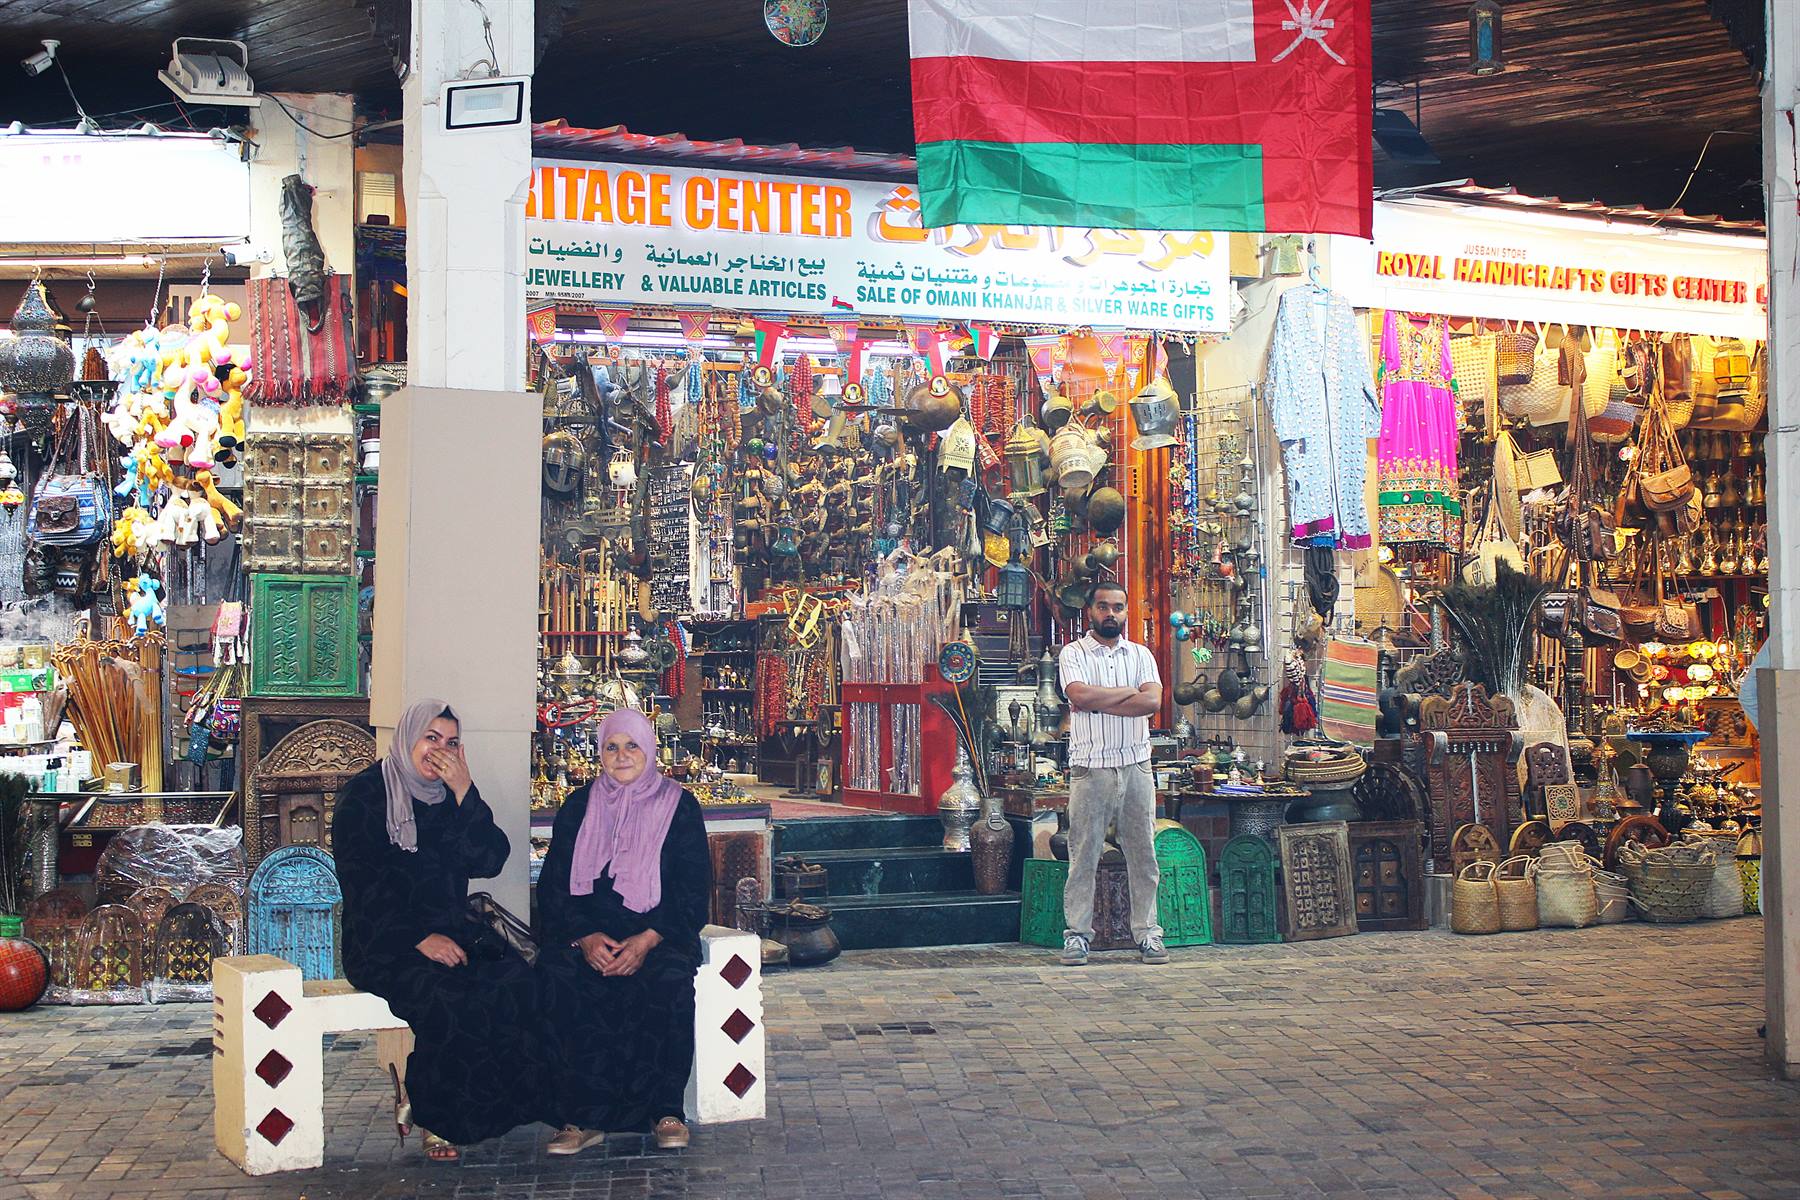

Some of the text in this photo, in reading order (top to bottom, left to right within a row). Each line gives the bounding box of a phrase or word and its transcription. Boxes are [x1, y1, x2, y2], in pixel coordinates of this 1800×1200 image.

[684, 175, 852, 238] CENTER
[644, 243, 719, 268] العمانية
[721, 253, 794, 273] الخناجر
[1464, 244, 1527, 260] JUSBANI STORE
[798, 257, 826, 277] بيع
[856, 260, 906, 283] ثمينة
[1377, 250, 1446, 280] ROYAL
[1453, 257, 1606, 293] HANDICRAFTS
[1610, 270, 1668, 297] GIFTS
[1673, 275, 1748, 304] CENTER
[526, 268, 827, 301] JEWELLERY & VALUABLE ARTICLES
[1167, 279, 1211, 300] تجارة
[855, 285, 1215, 323] SALE OF OMANI KHANJAR & SILVER WARE GIFTS
